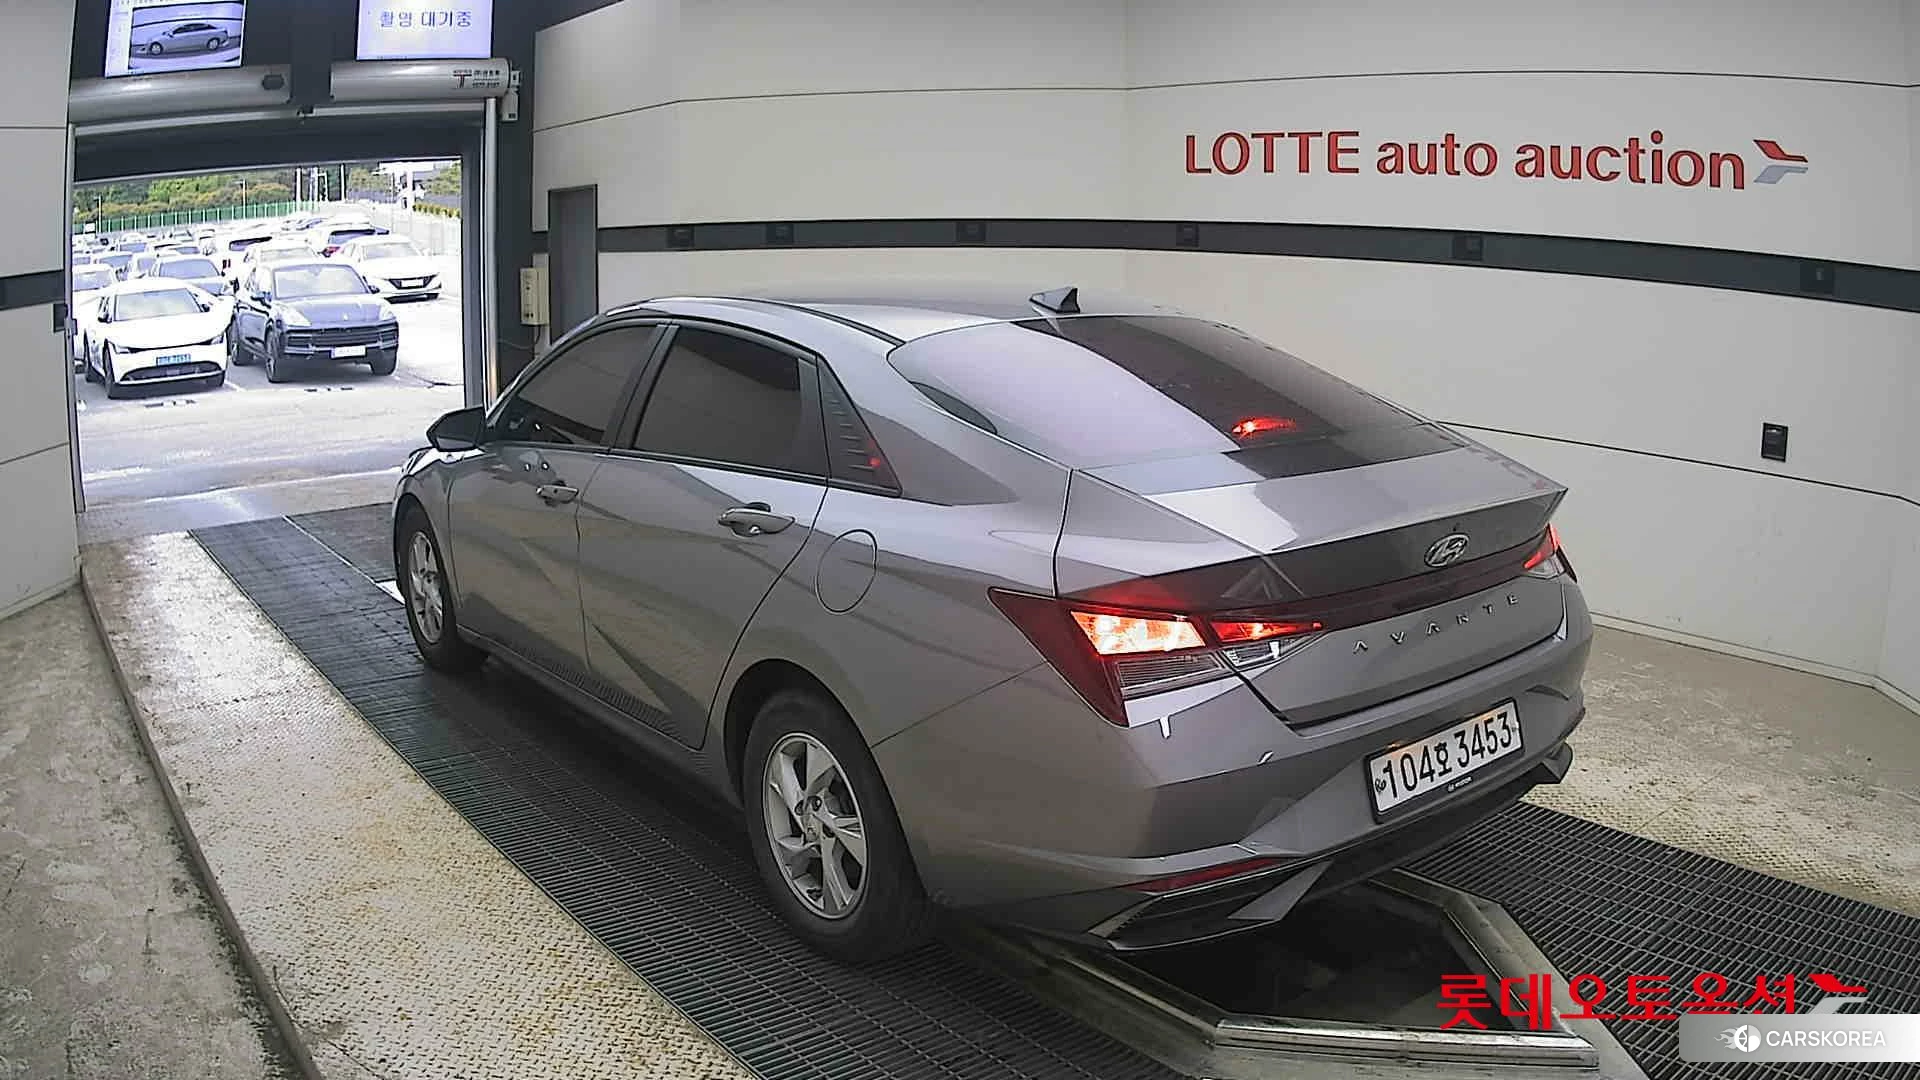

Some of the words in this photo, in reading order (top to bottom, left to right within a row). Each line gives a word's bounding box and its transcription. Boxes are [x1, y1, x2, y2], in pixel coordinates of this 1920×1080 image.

[421, 11, 471, 27] 대기중
[1186, 131, 1361, 175] LOTTE
[1377, 133, 1498, 177] auto
[1514, 131, 1745, 190] auction
[1352, 594, 1519, 655] AVANTE
[1383, 741, 1452, 798] 104호
[1454, 711, 1512, 768] 3453
